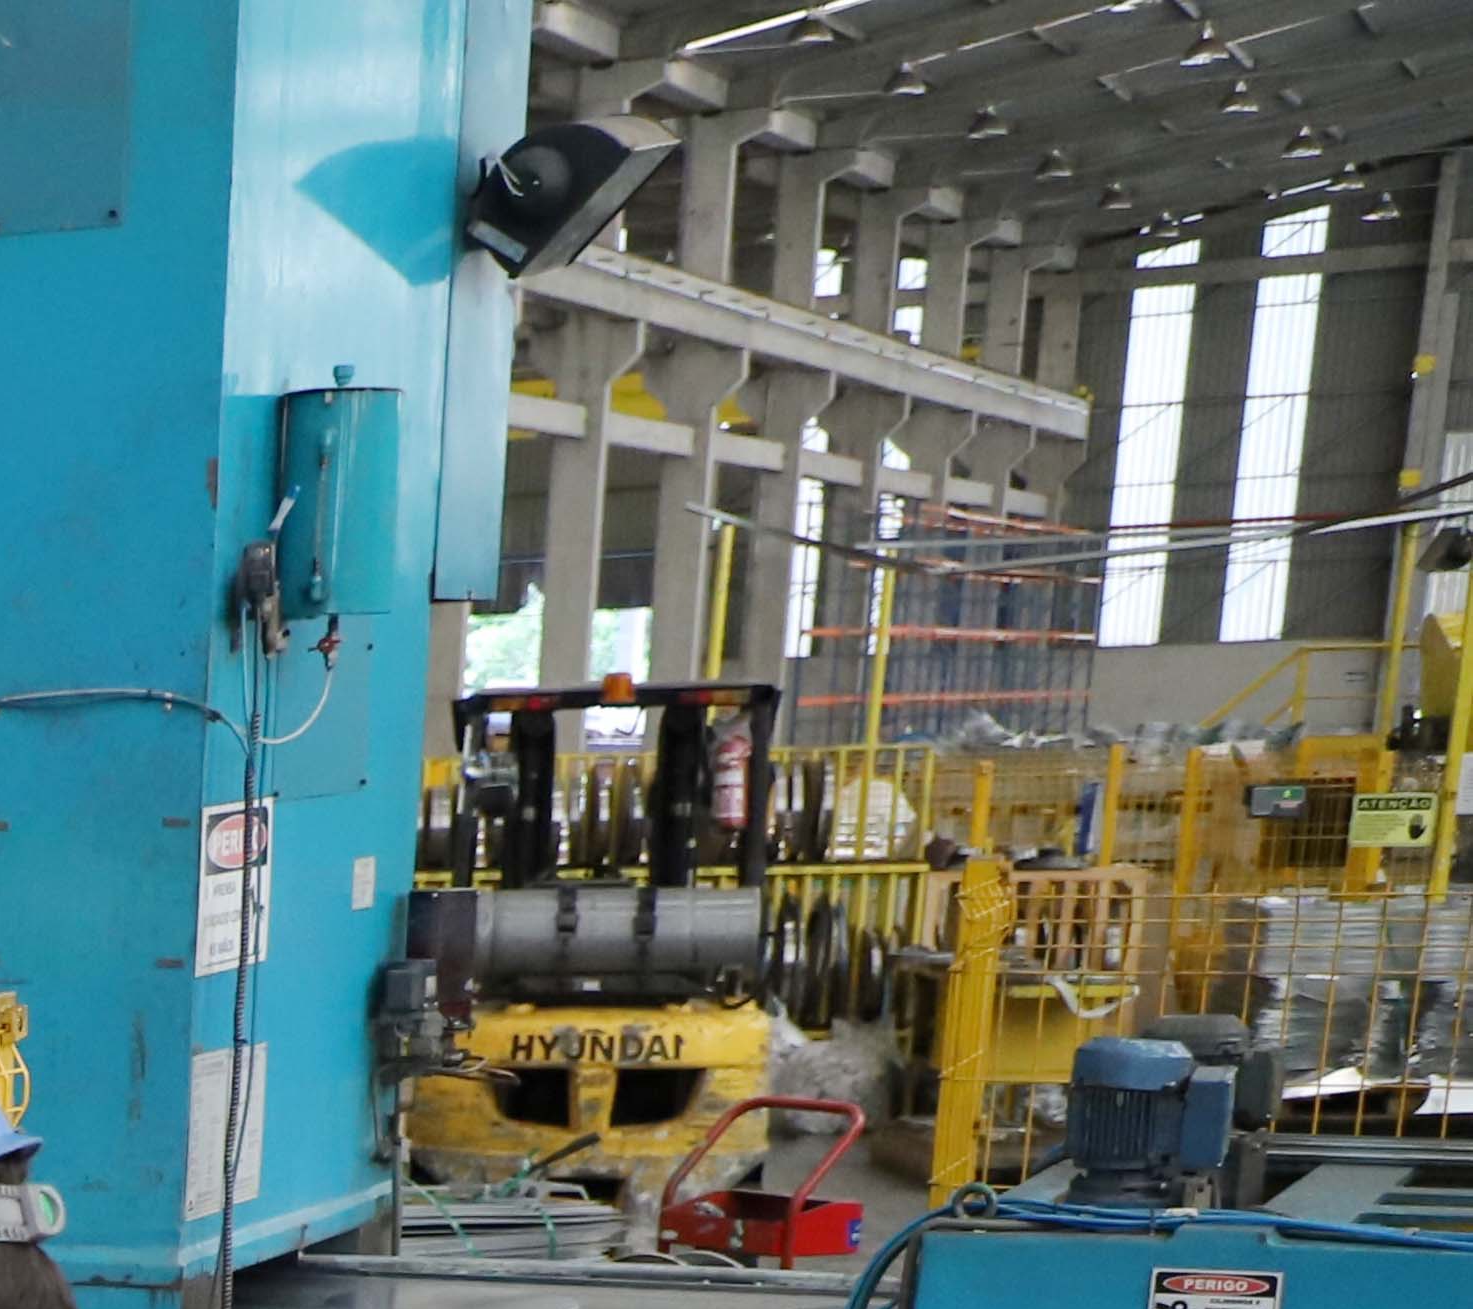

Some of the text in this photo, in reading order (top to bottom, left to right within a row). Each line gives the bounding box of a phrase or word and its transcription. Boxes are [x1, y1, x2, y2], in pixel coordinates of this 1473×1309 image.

[1359, 797, 1430, 811] ATENÇÃO
[510, 1034, 684, 1061] HYUNDAI
[1184, 1279, 1249, 1292] PERIGO
